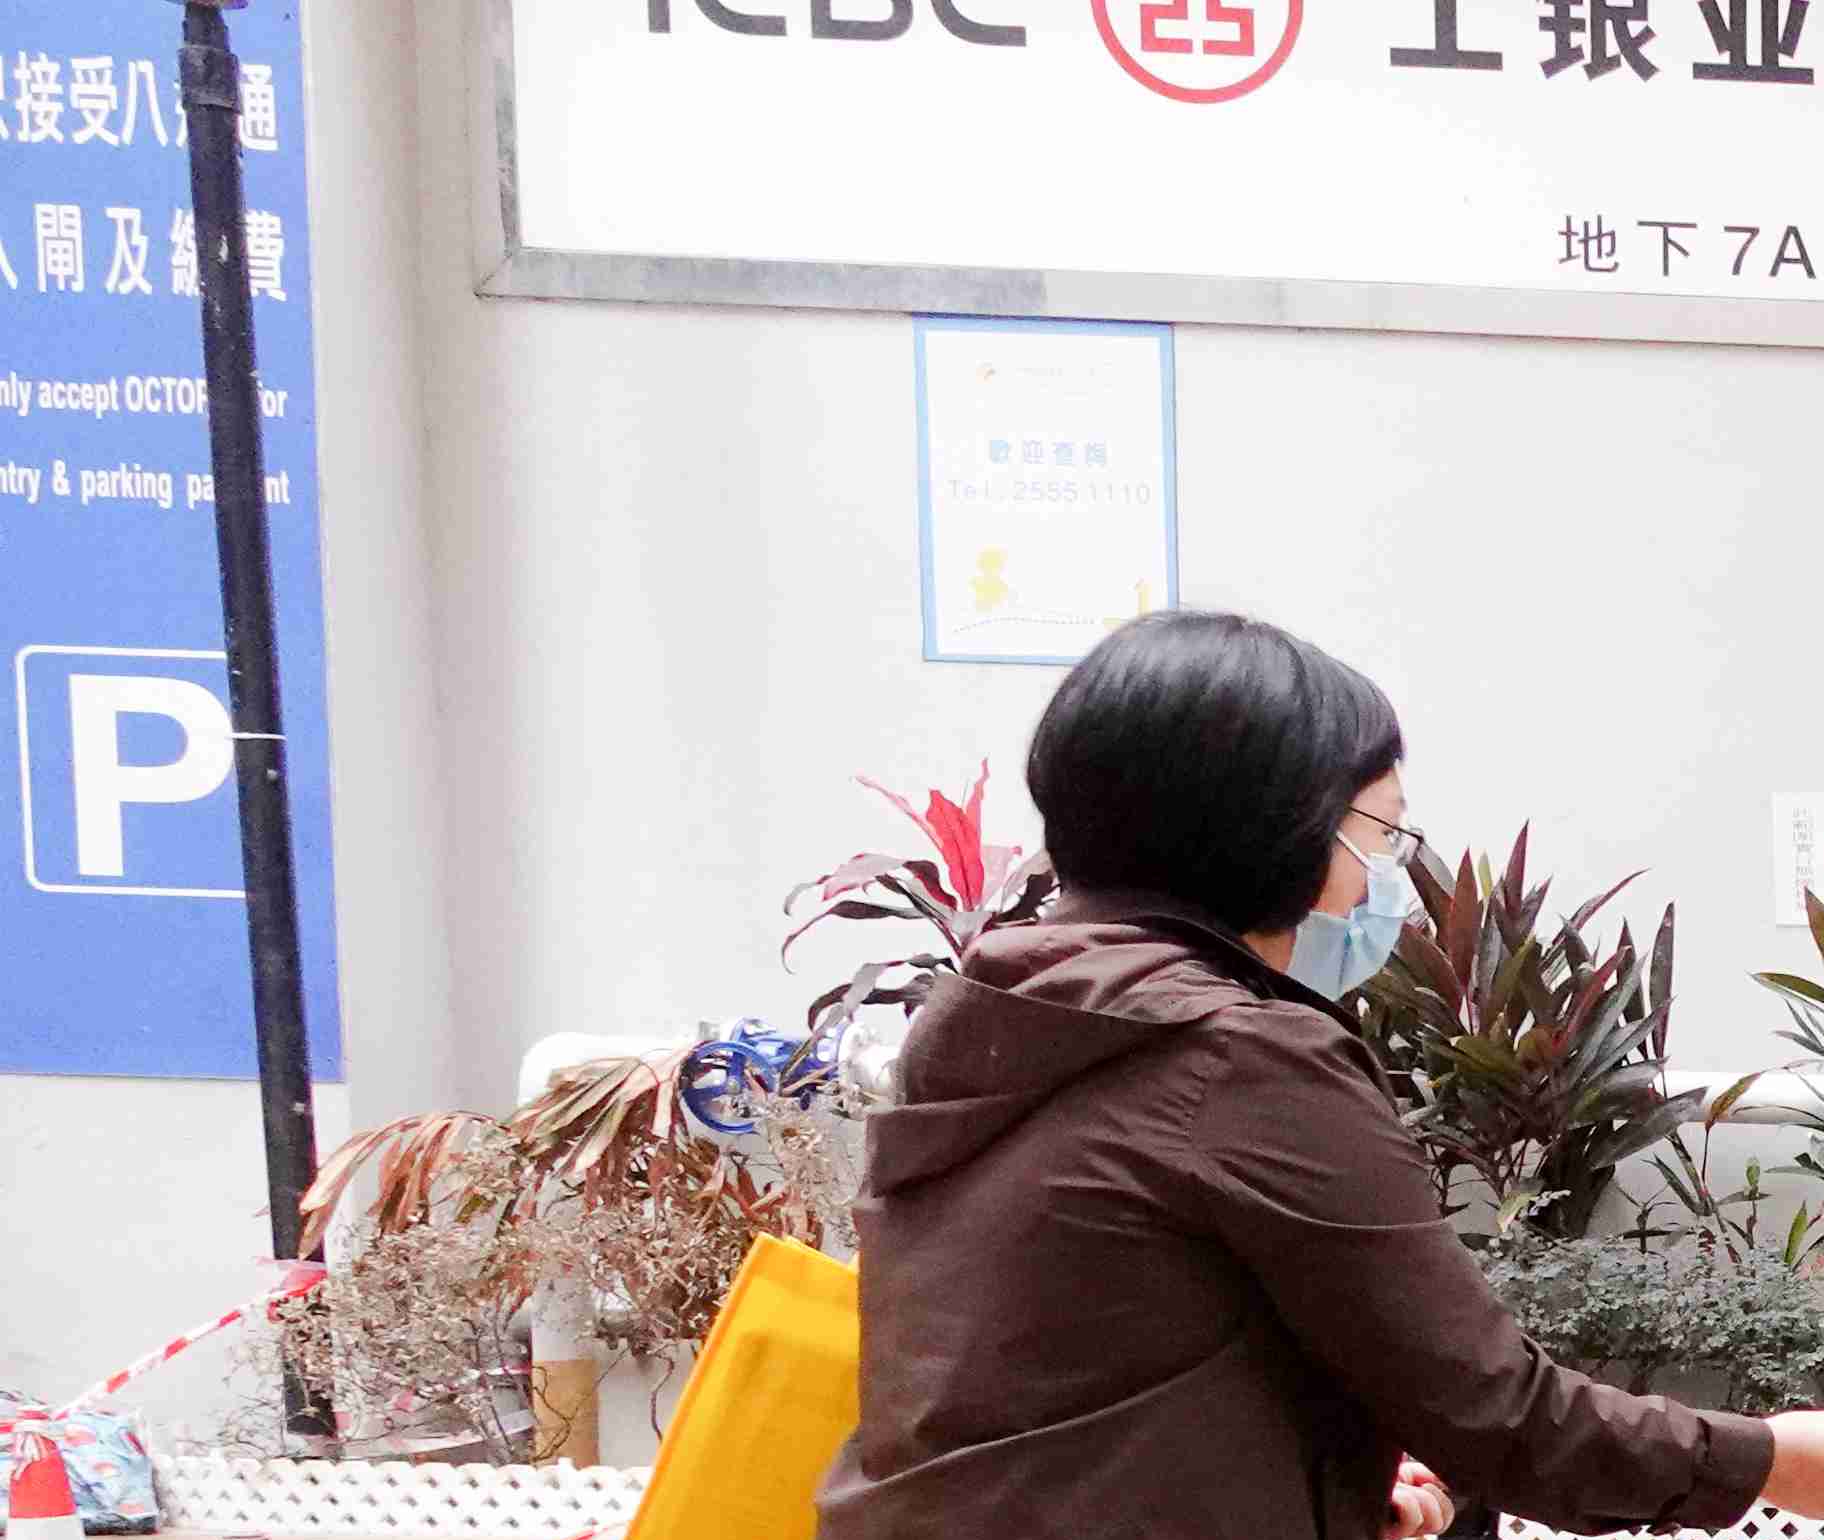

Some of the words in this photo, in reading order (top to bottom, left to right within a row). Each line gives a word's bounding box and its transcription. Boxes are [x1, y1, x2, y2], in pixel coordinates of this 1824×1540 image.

[0, 51, 279, 150] 接受八通
[0, 371, 33, 417] nly
[38, 377, 119, 419] accept
[124, 376, 209, 417] OCTOP
[259, 383, 289, 418] or
[0, 461, 42, 504] ntry
[53, 460, 71, 496] &
[80, 463, 173, 509] parking
[187, 470, 290, 510] pant
[68, 674, 234, 877] P
